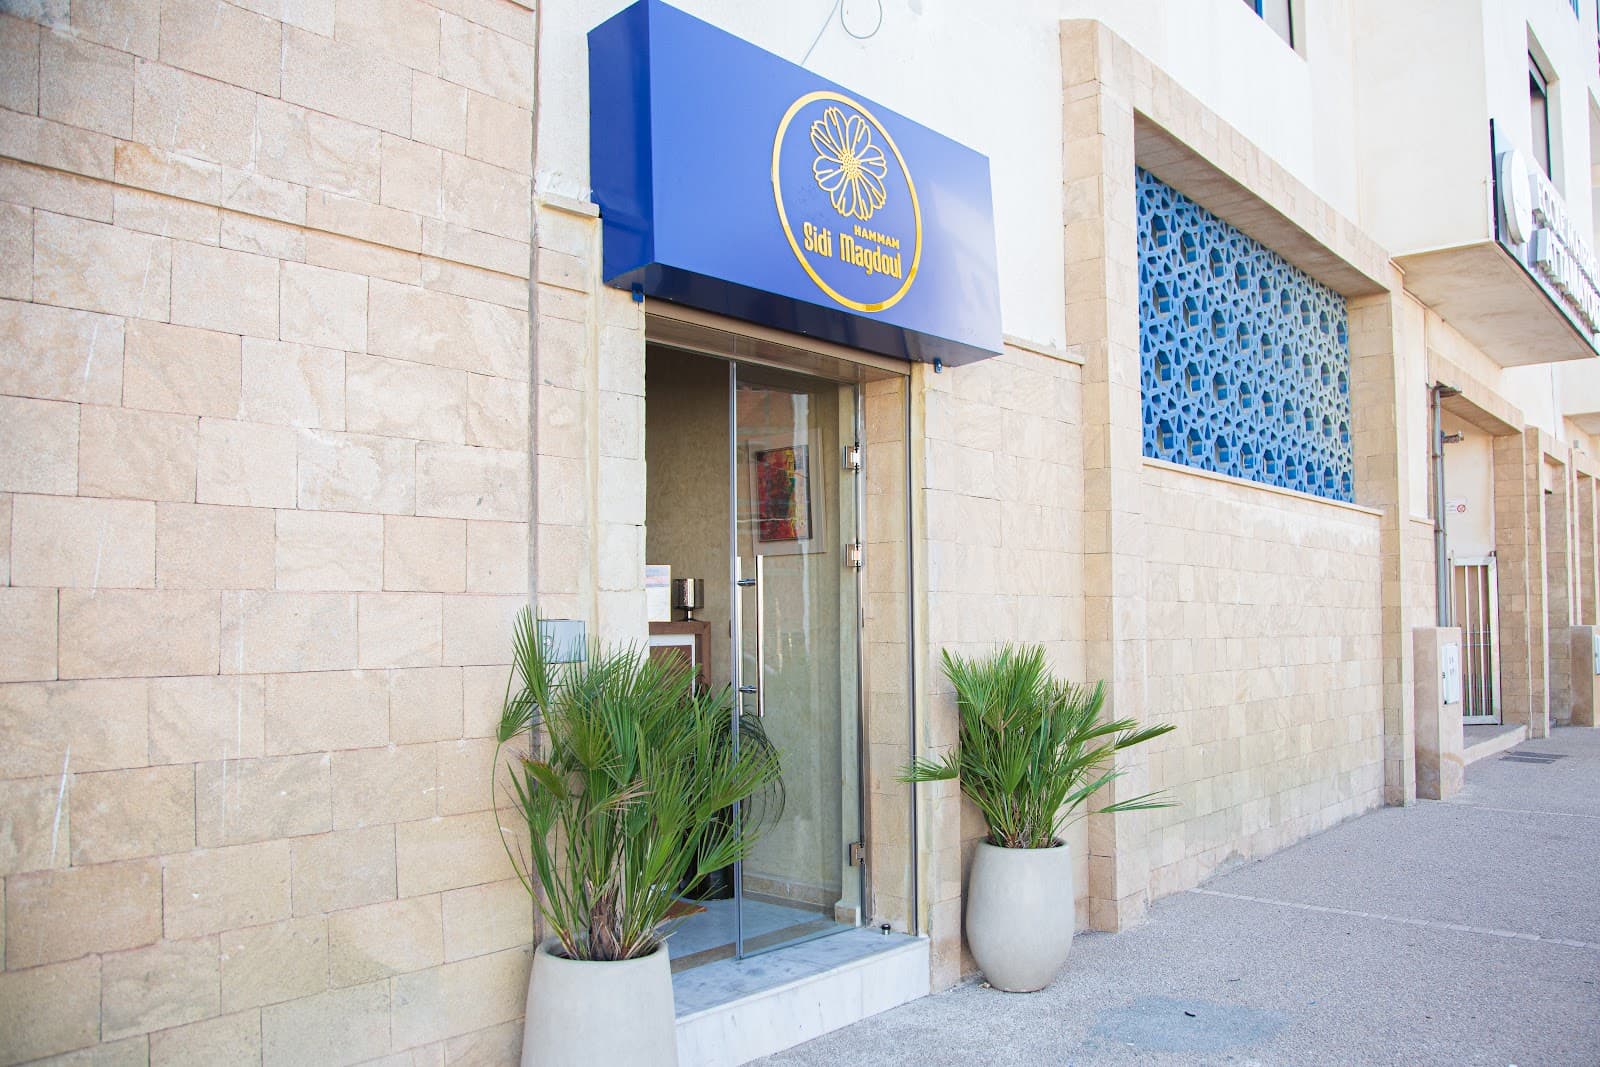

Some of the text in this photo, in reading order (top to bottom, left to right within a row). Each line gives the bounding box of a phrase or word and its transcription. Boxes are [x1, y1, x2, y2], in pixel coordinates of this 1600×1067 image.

[803, 221, 902, 280] Sidi Magdoul
[853, 224, 900, 250] HAMMAM
